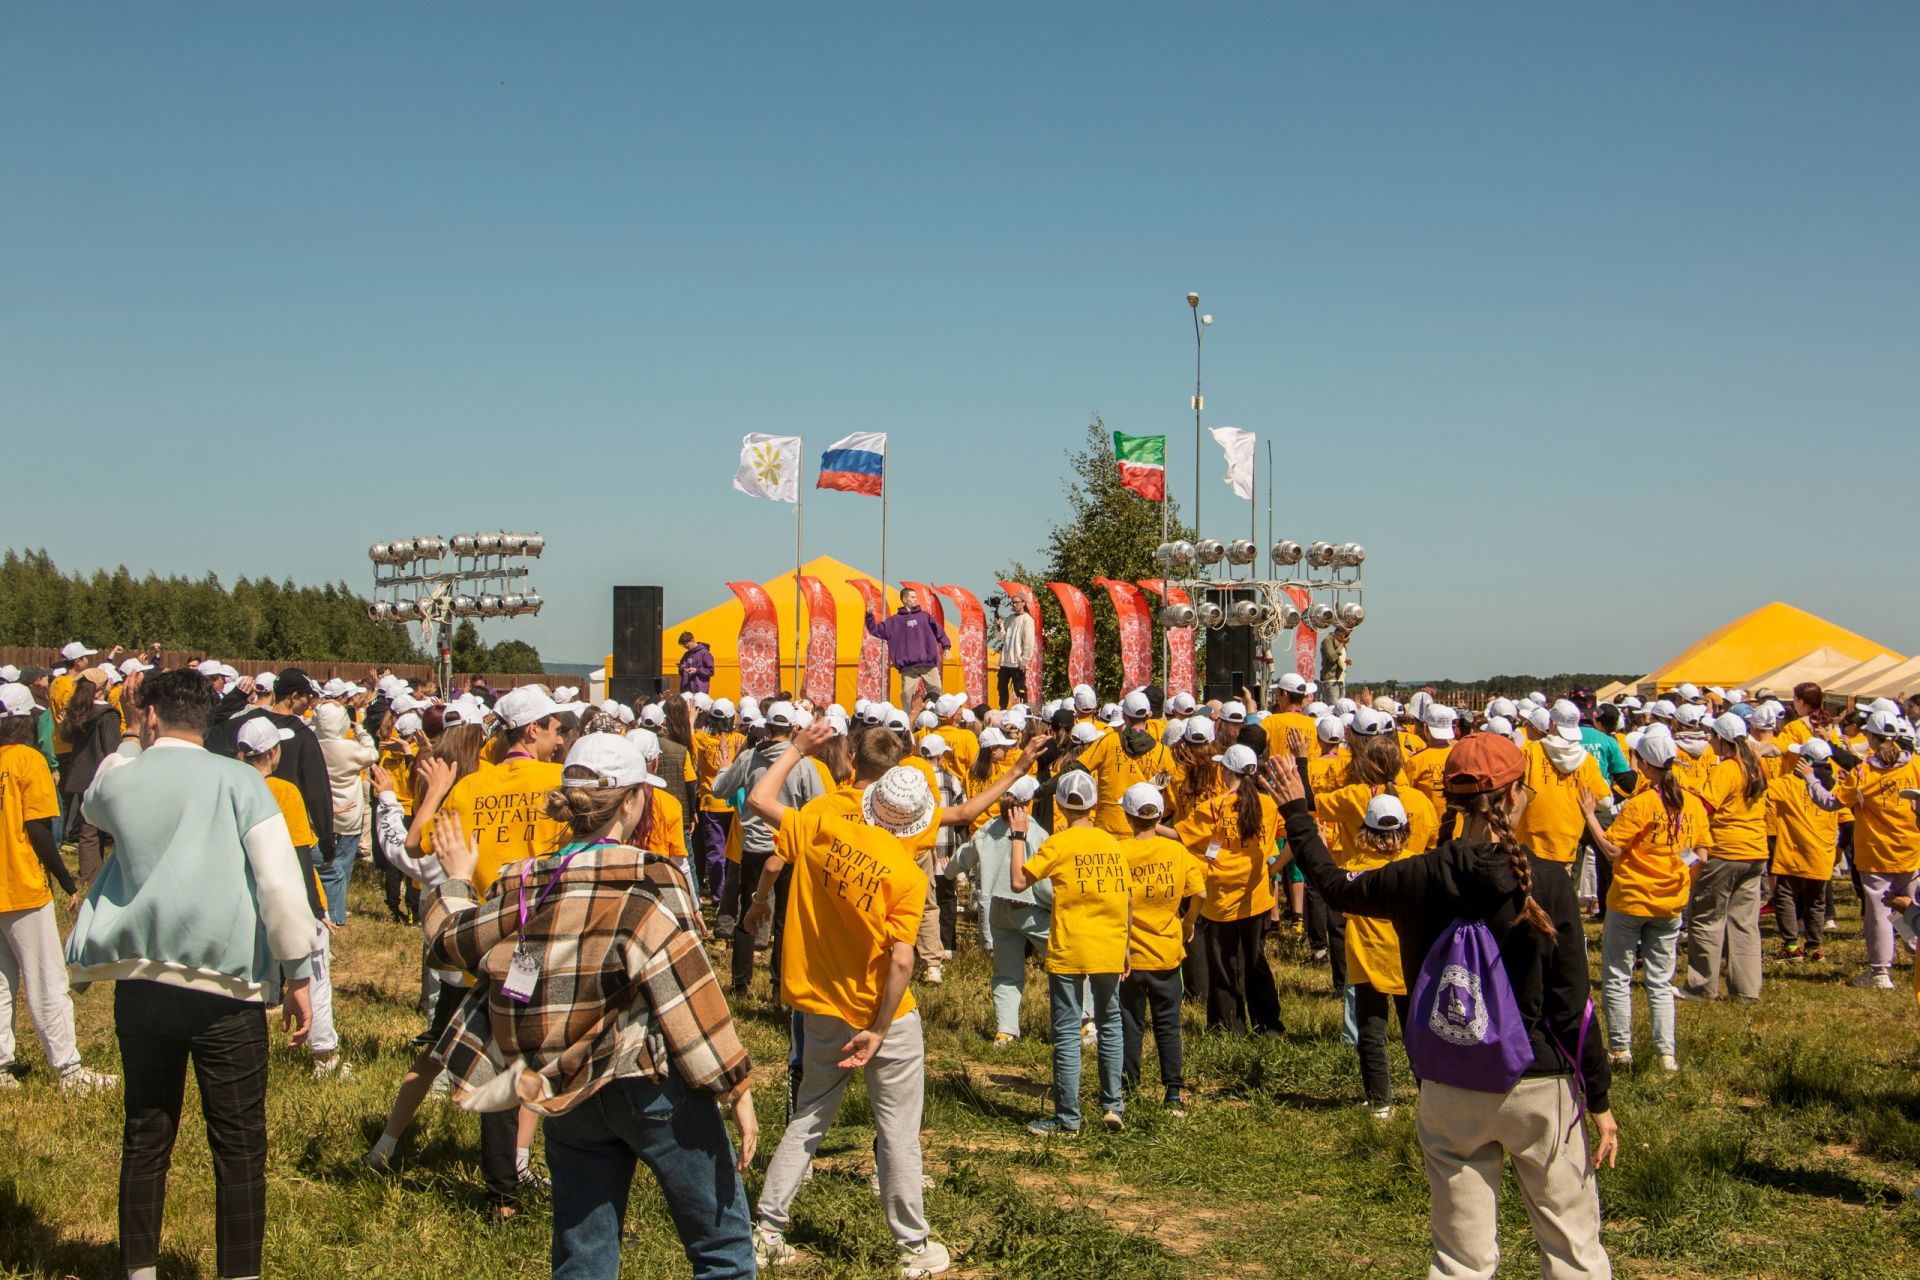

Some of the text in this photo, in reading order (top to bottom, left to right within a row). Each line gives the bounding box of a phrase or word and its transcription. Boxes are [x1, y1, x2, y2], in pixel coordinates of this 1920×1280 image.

[474, 792, 541, 810] БОЛГАР
[473, 808, 537, 826] ТУГАН
[473, 825, 535, 844] ТЕЛ
[830, 838, 891, 877] БОЛГАР
[1075, 853, 1121, 867] БОЛГАР
[824, 853, 880, 894] ТУГАН
[1075, 866, 1124, 879] ТУГАН
[822, 869, 873, 912] ТЕЛ
[1077, 879, 1126, 894] ТЕЛ
